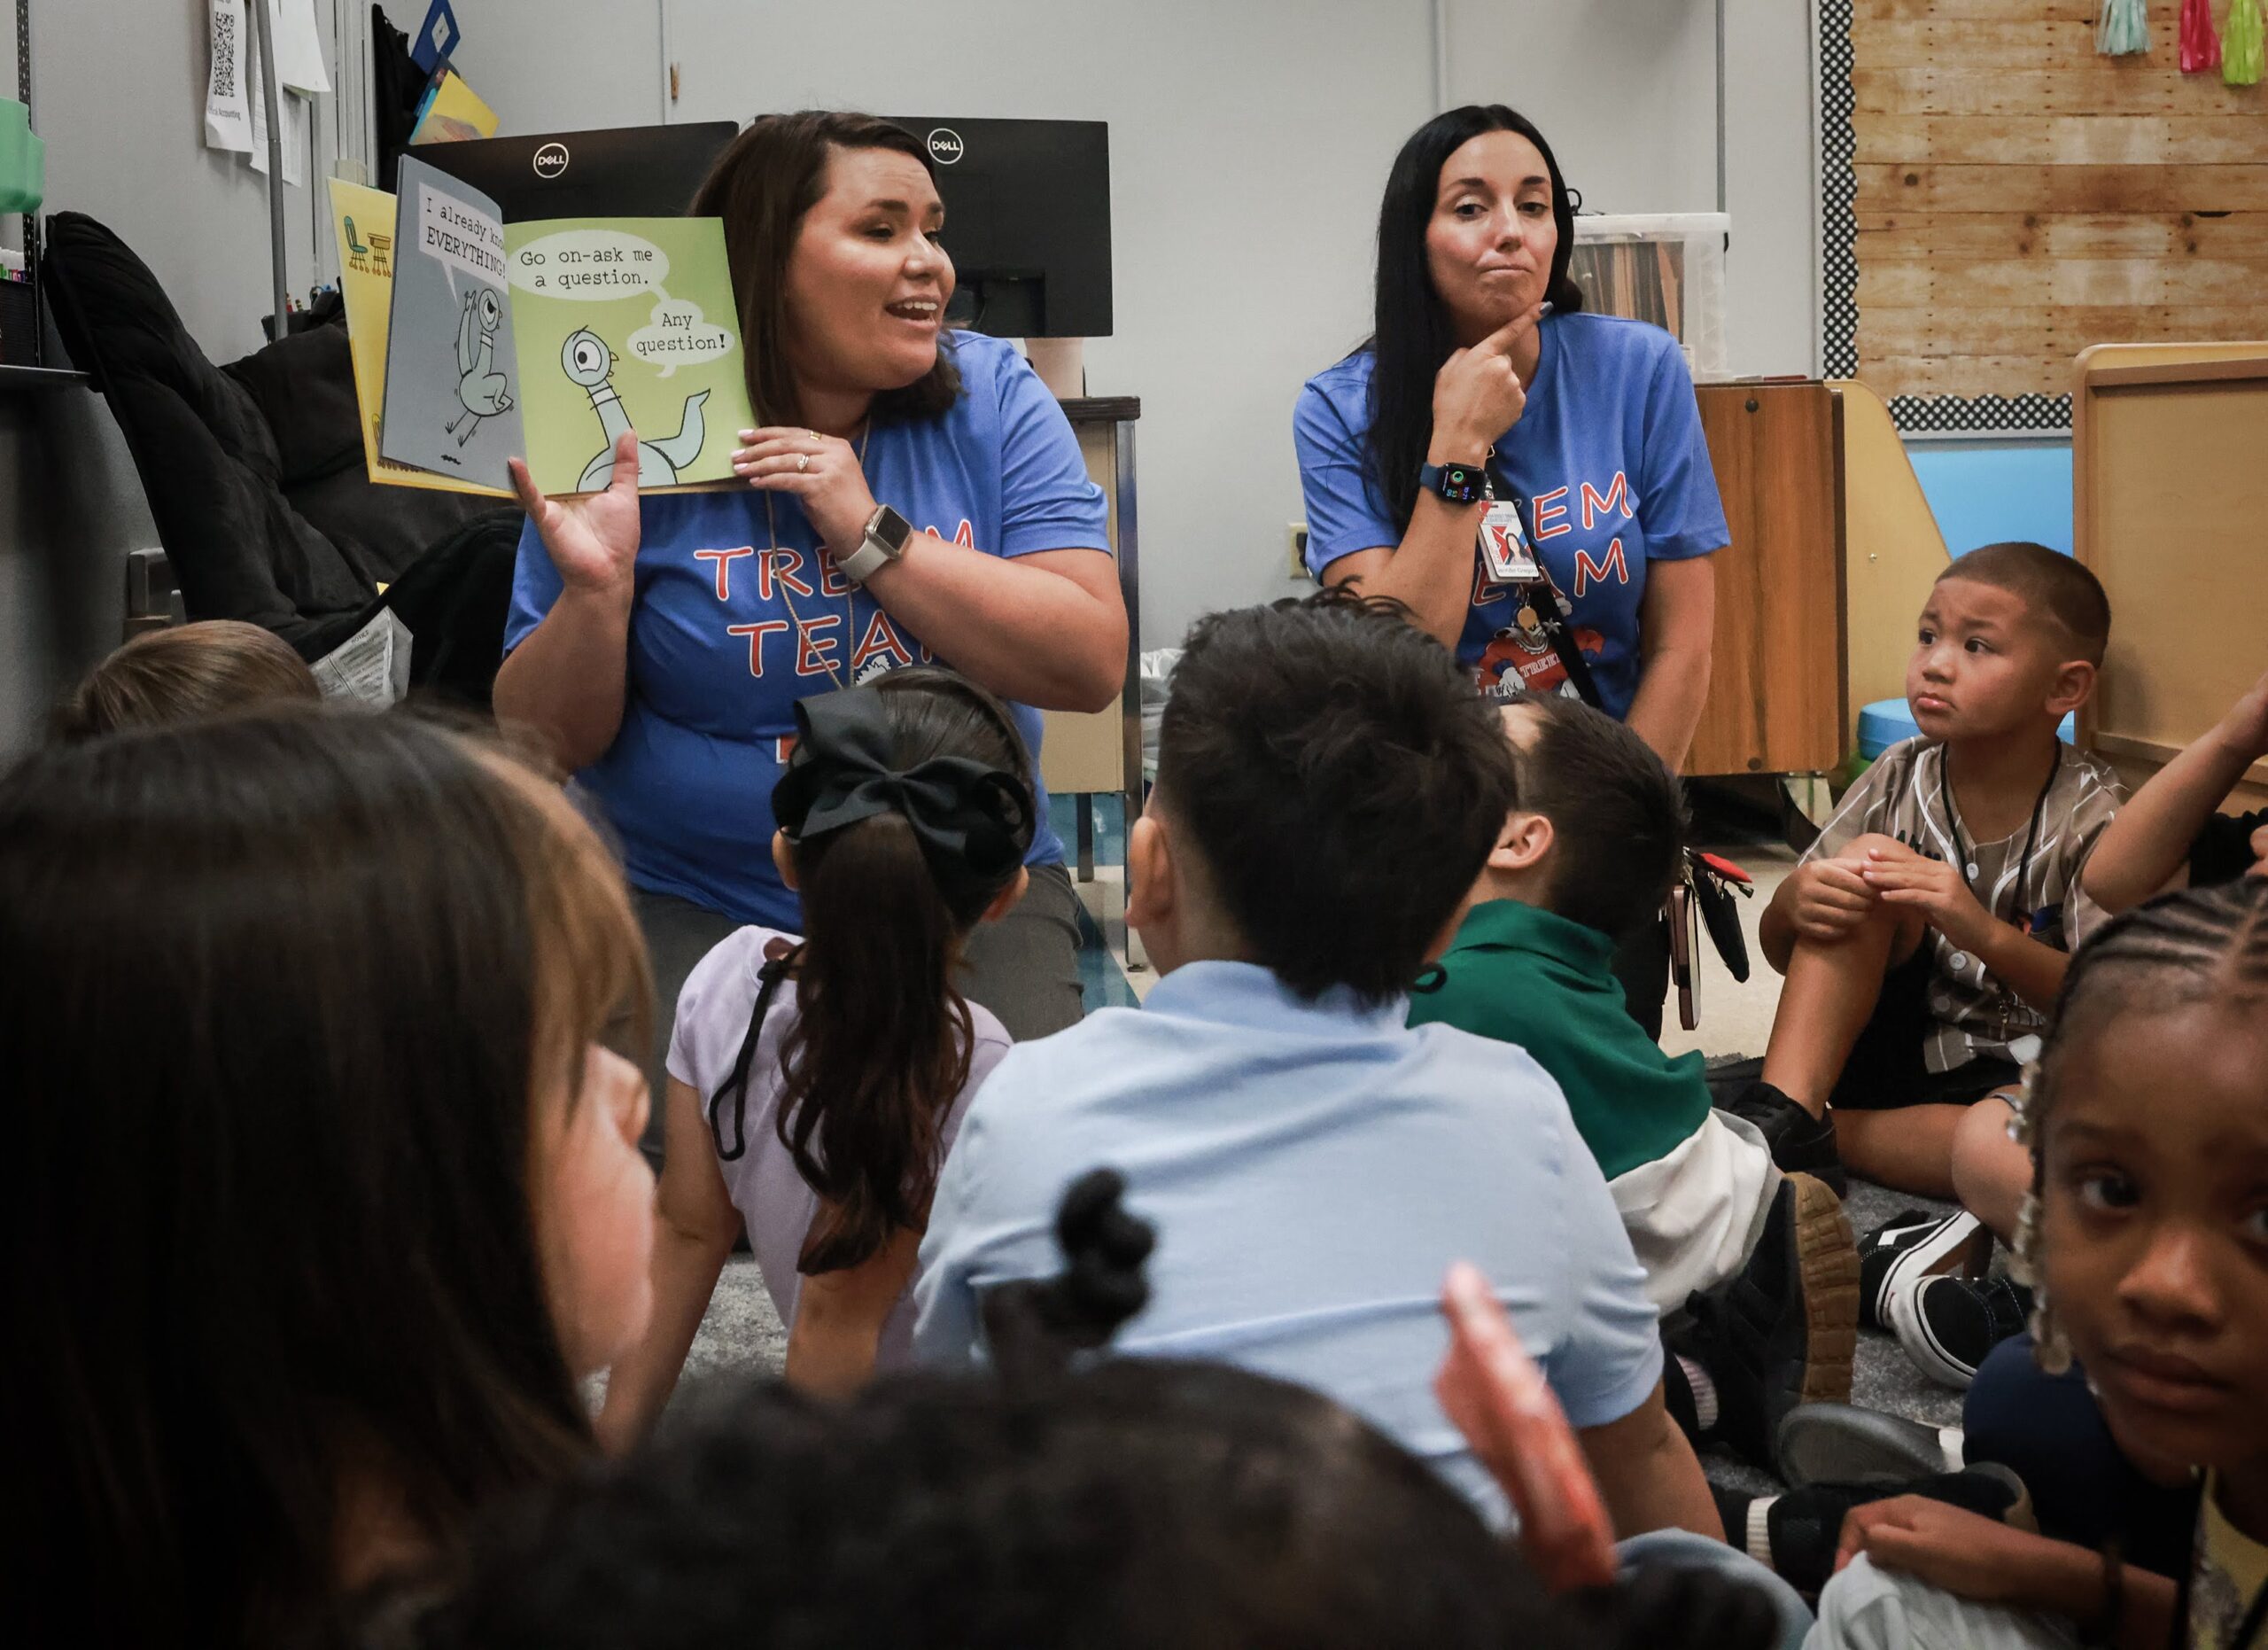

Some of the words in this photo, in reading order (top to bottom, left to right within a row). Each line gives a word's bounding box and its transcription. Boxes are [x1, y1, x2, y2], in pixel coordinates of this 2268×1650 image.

[932, 140, 960, 152] DELL
[538, 155, 565, 166] DELL
[426, 197, 432, 213] I
[439, 206, 487, 242] already
[490, 227, 505, 251] kno
[426, 225, 506, 279] EVERYTHING!
[520, 251, 546, 266] Go
[558, 247, 624, 263] on-ask
[633, 250, 653, 261] me
[535, 275, 547, 288] a
[558, 269, 649, 290] question.
[662, 312, 693, 331] Any
[636, 333, 726, 356] question!
[726, 609, 934, 678] TEA
